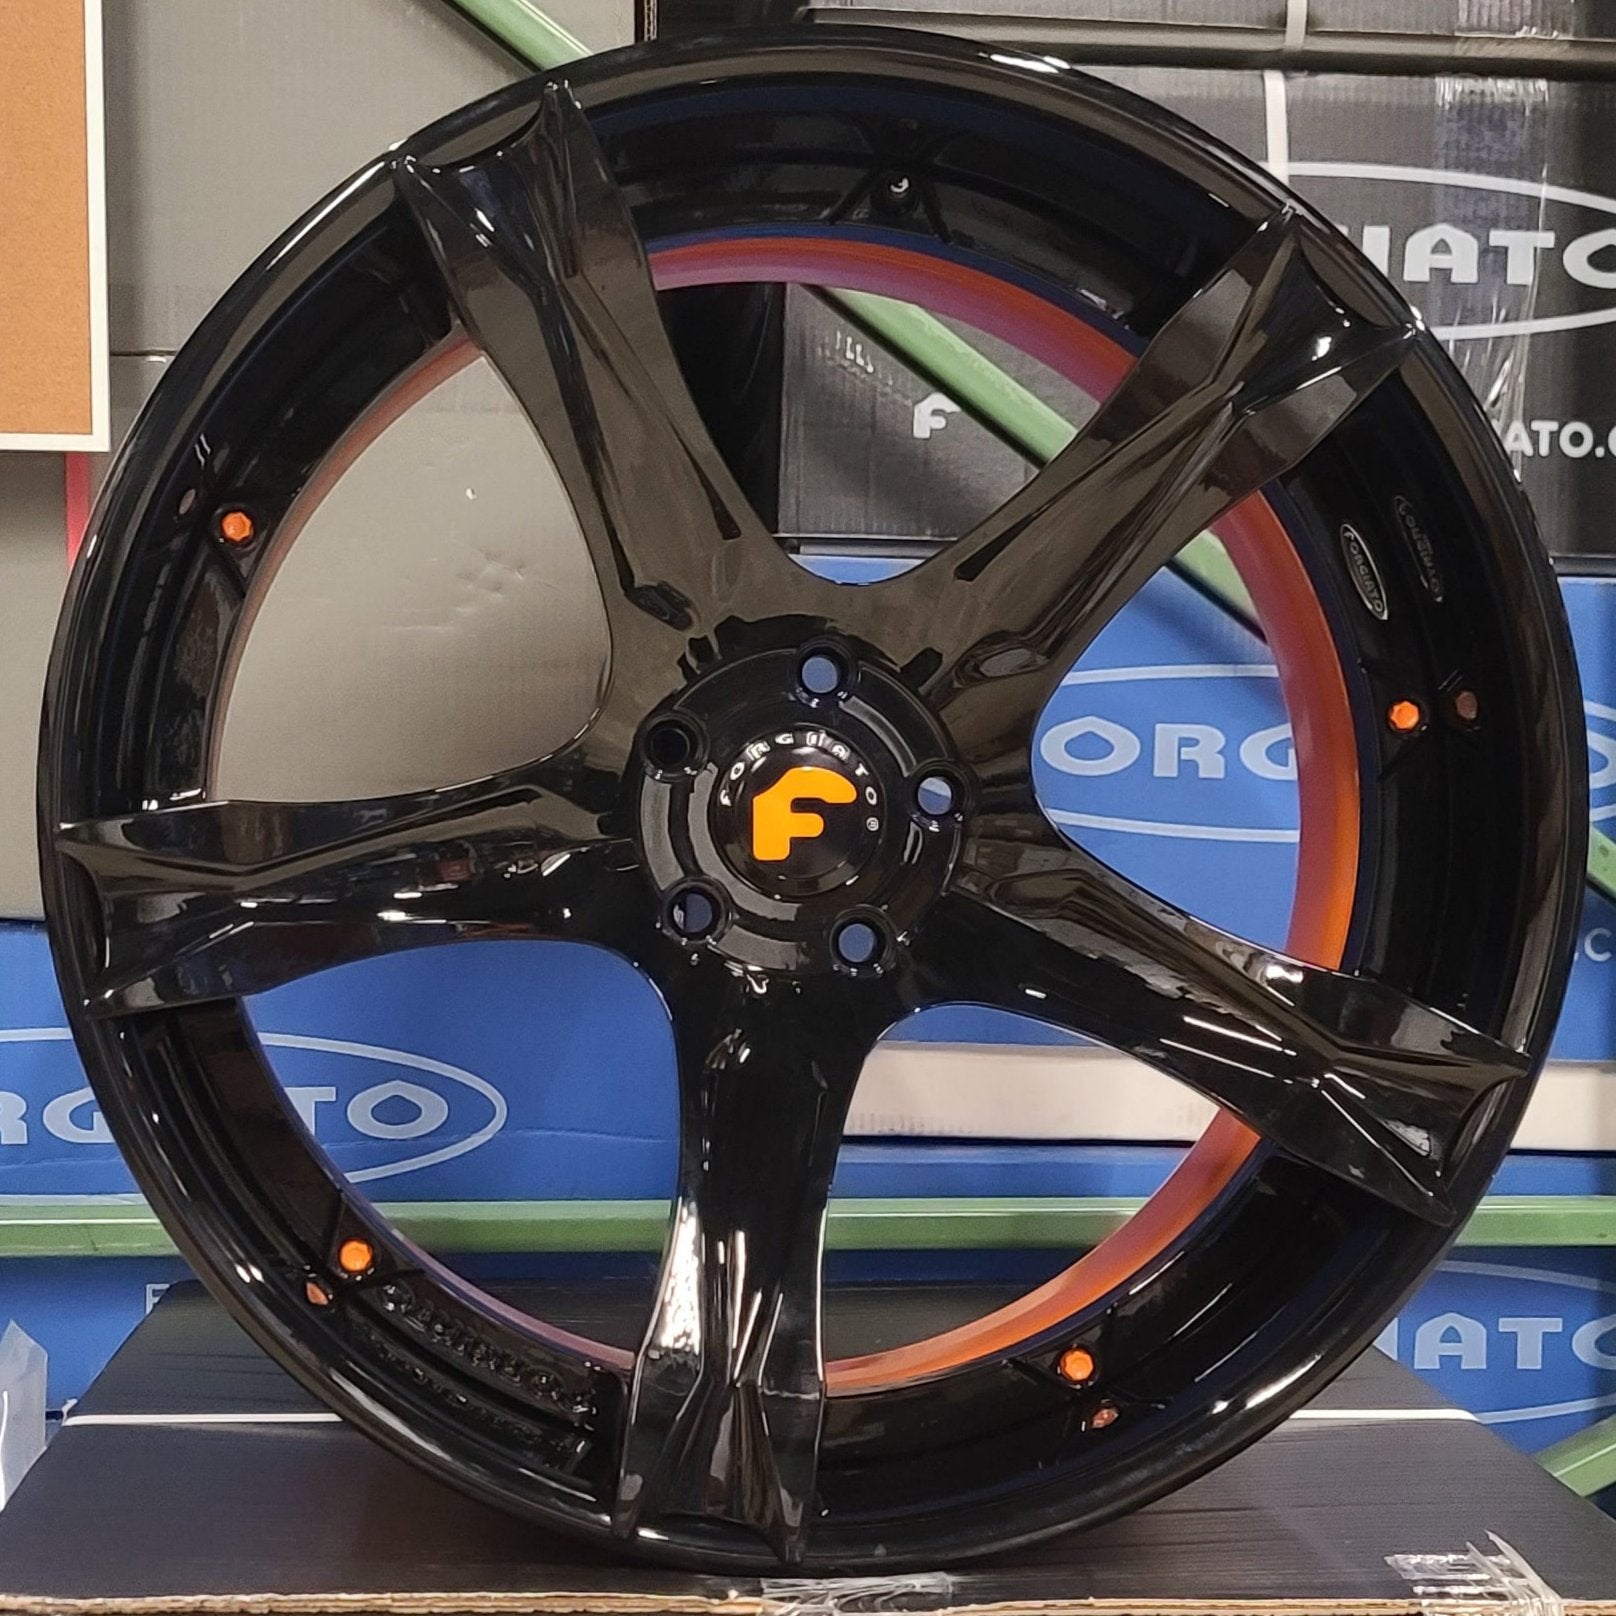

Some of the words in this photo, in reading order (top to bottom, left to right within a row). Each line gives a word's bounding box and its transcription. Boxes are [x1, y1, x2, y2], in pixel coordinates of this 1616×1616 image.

[1338, 223, 1616, 290] IATO
[1491, 419, 1616, 459] ATO.
[752, 765, 858, 861] F
